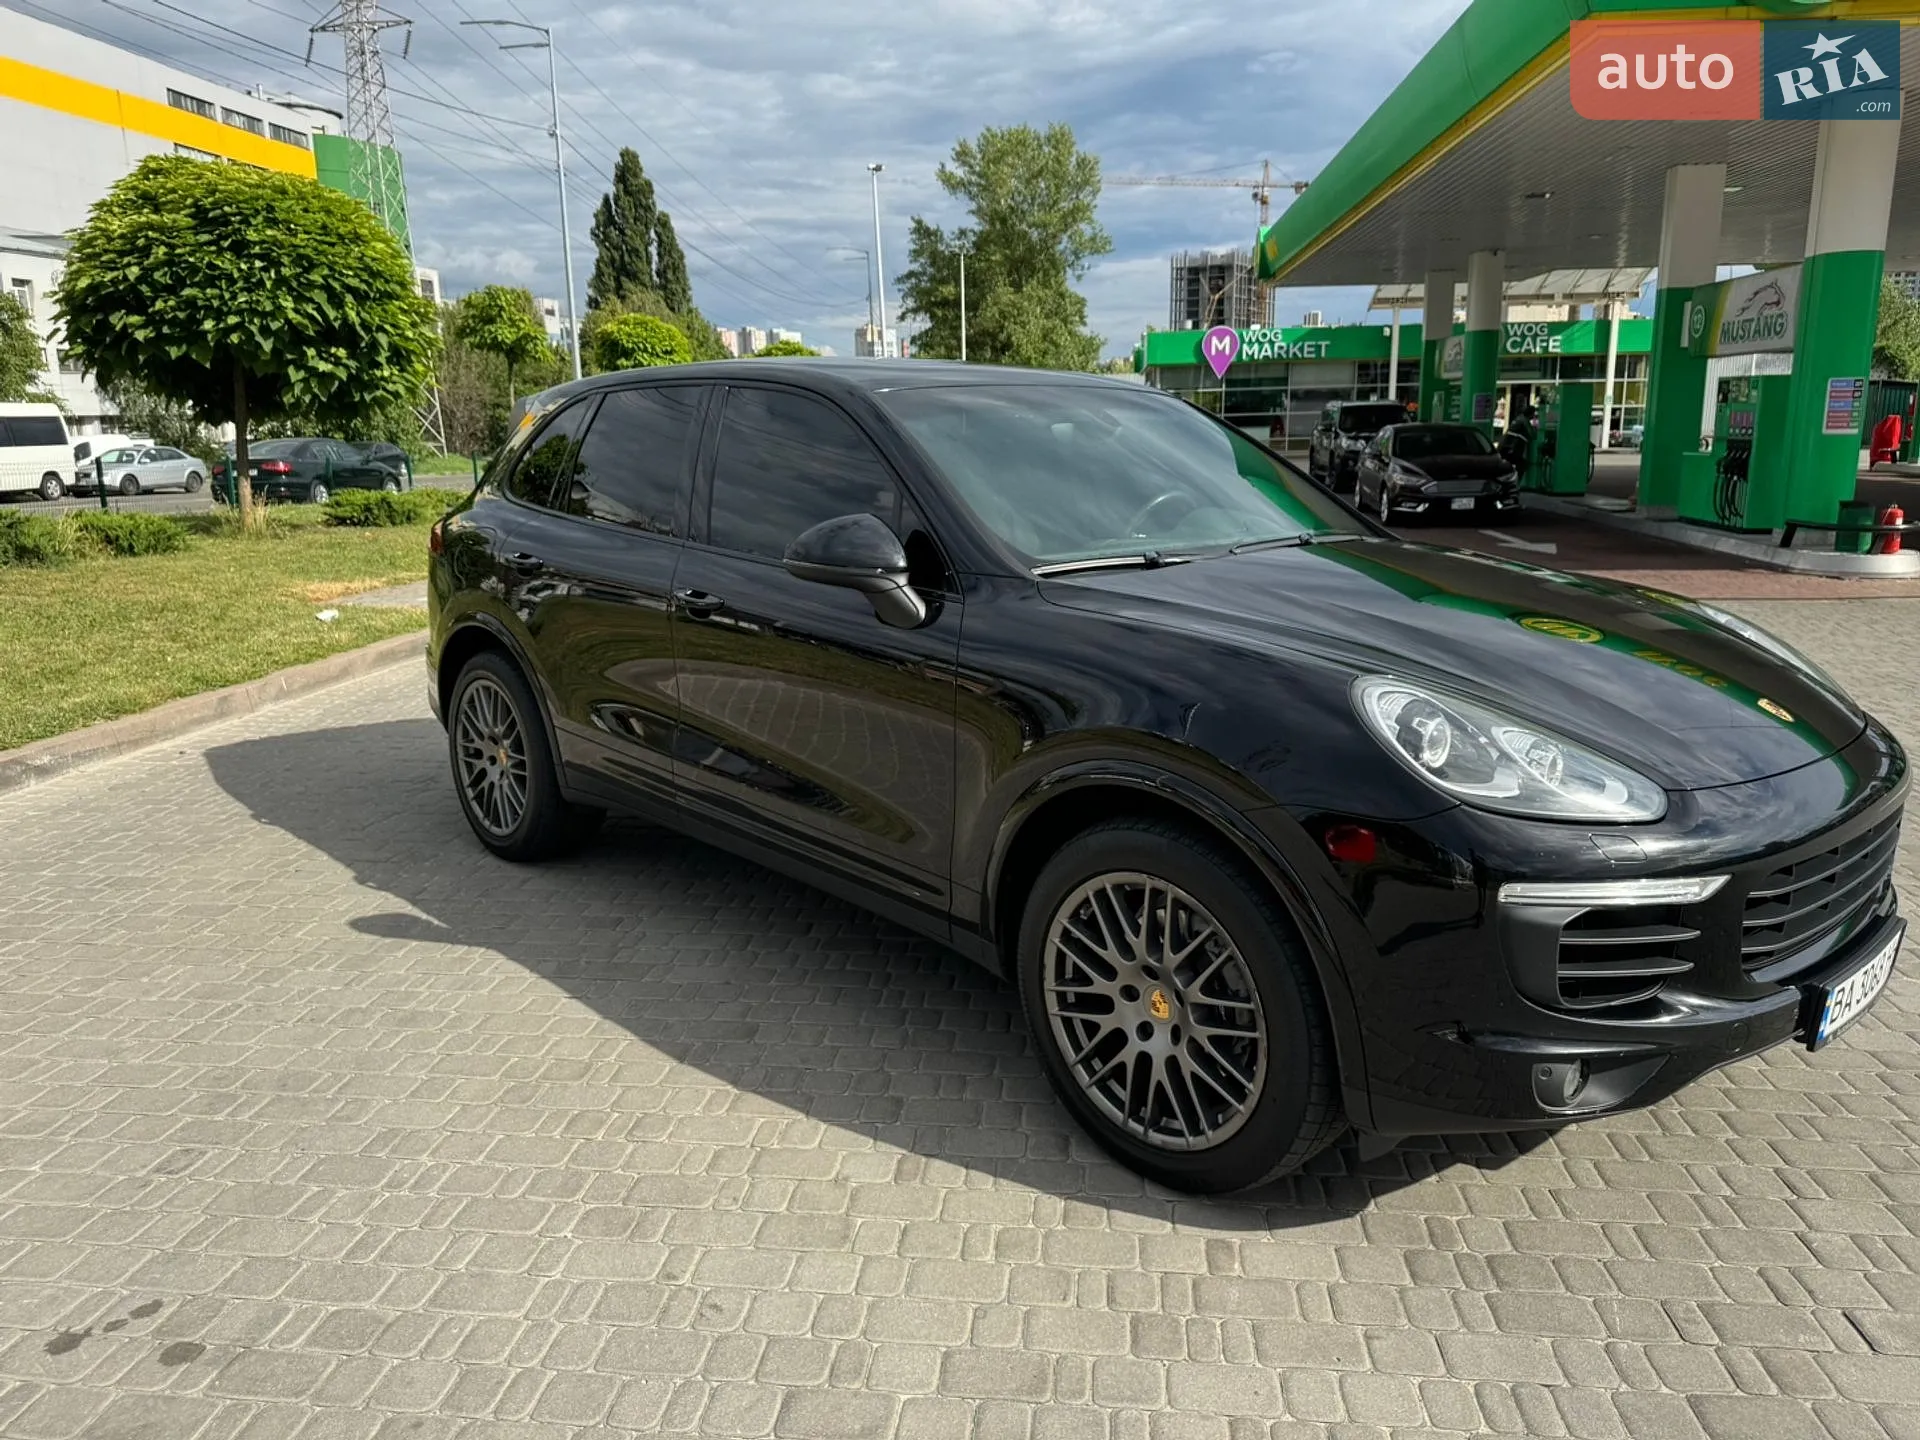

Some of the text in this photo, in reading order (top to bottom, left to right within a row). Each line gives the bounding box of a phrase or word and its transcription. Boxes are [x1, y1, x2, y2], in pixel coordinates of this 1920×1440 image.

[1243, 330, 1283, 342] WOG
[1507, 323, 1548, 336] WOG
[1719, 310, 1788, 344] MUSTANG
[1211, 335, 1231, 356] M
[1242, 341, 1330, 360] MARKET
[1506, 335, 1561, 353] CAFE
[1829, 980, 1855, 1025] BA
